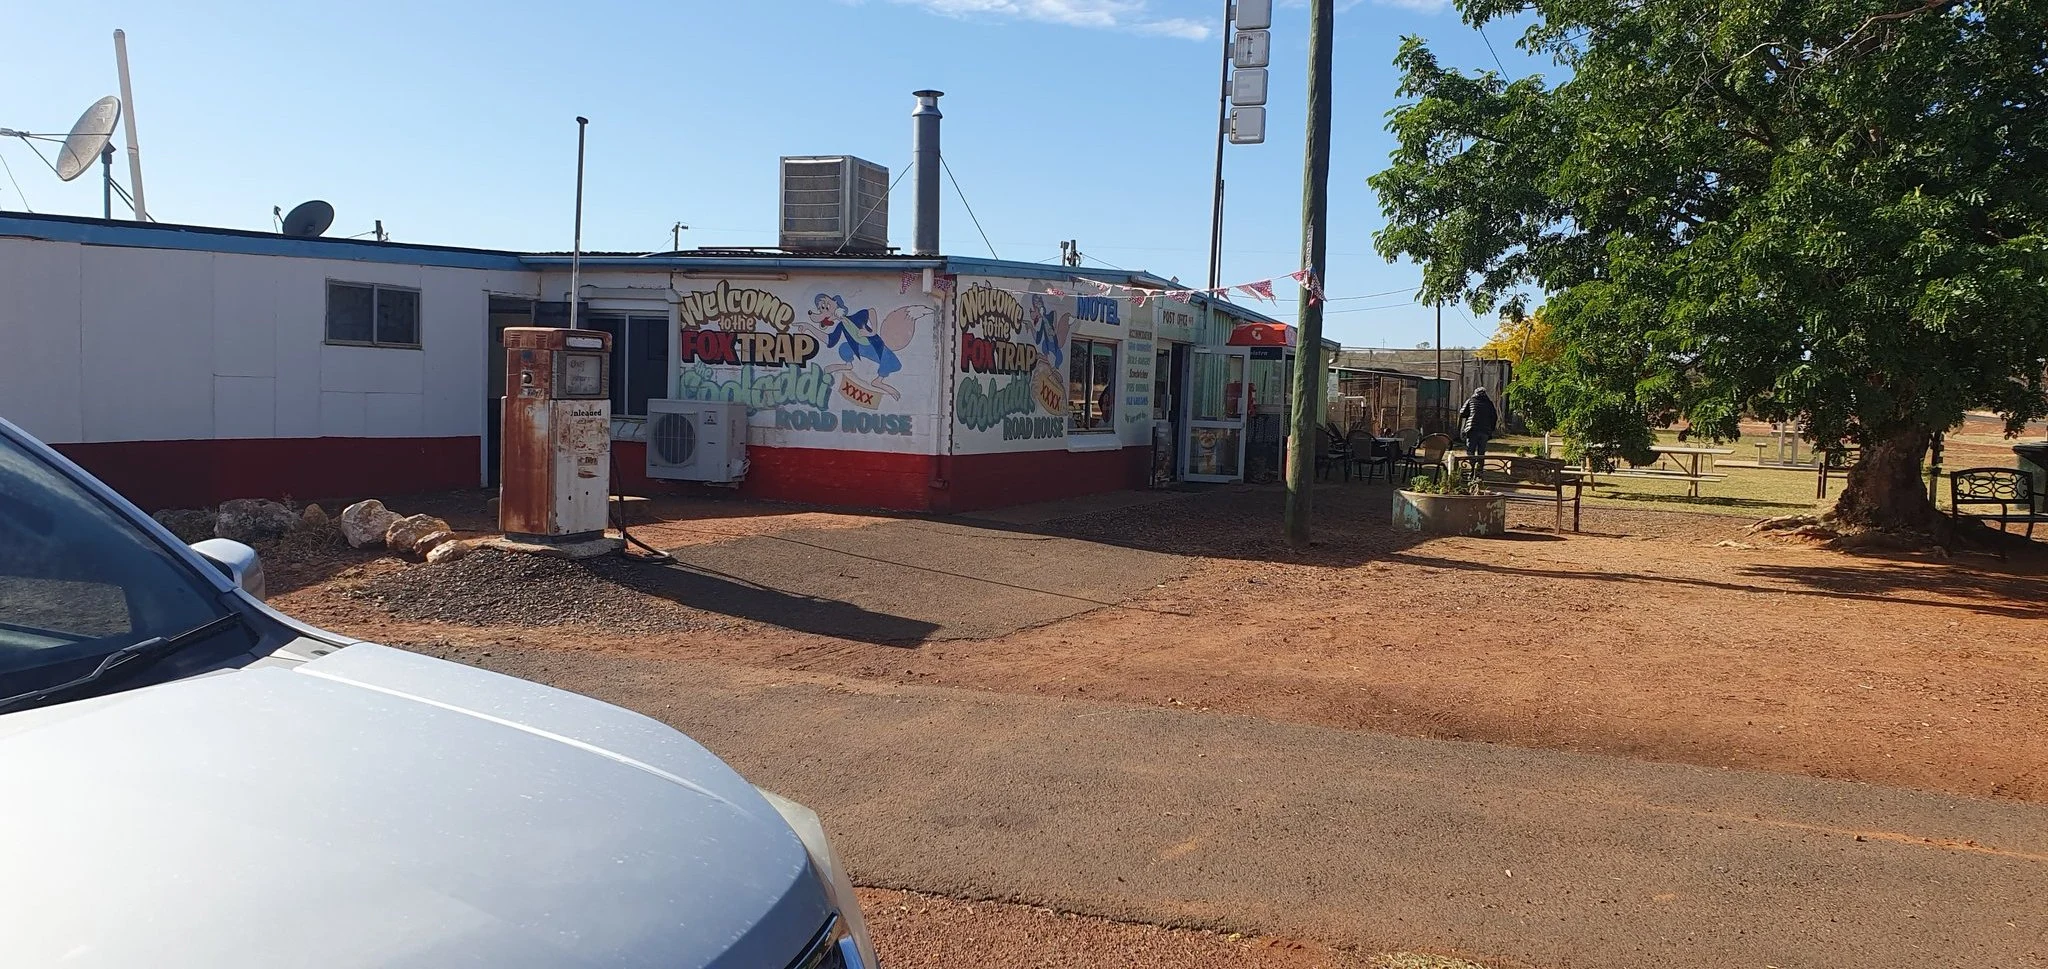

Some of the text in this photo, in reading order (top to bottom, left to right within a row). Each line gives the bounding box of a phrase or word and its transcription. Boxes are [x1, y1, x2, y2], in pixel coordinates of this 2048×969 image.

[681, 279, 795, 332] Welcome
[959, 280, 1024, 335] Welcome
[1077, 293, 1121, 326] MOTEL
[1162, 310, 1176, 325] POST
[842, 380, 874, 405] XXXX
[1040, 379, 1062, 412] XXXX
[775, 406, 913, 436] ROAD HOUSE
[1002, 416, 1064, 440] ROAD HOUSE
